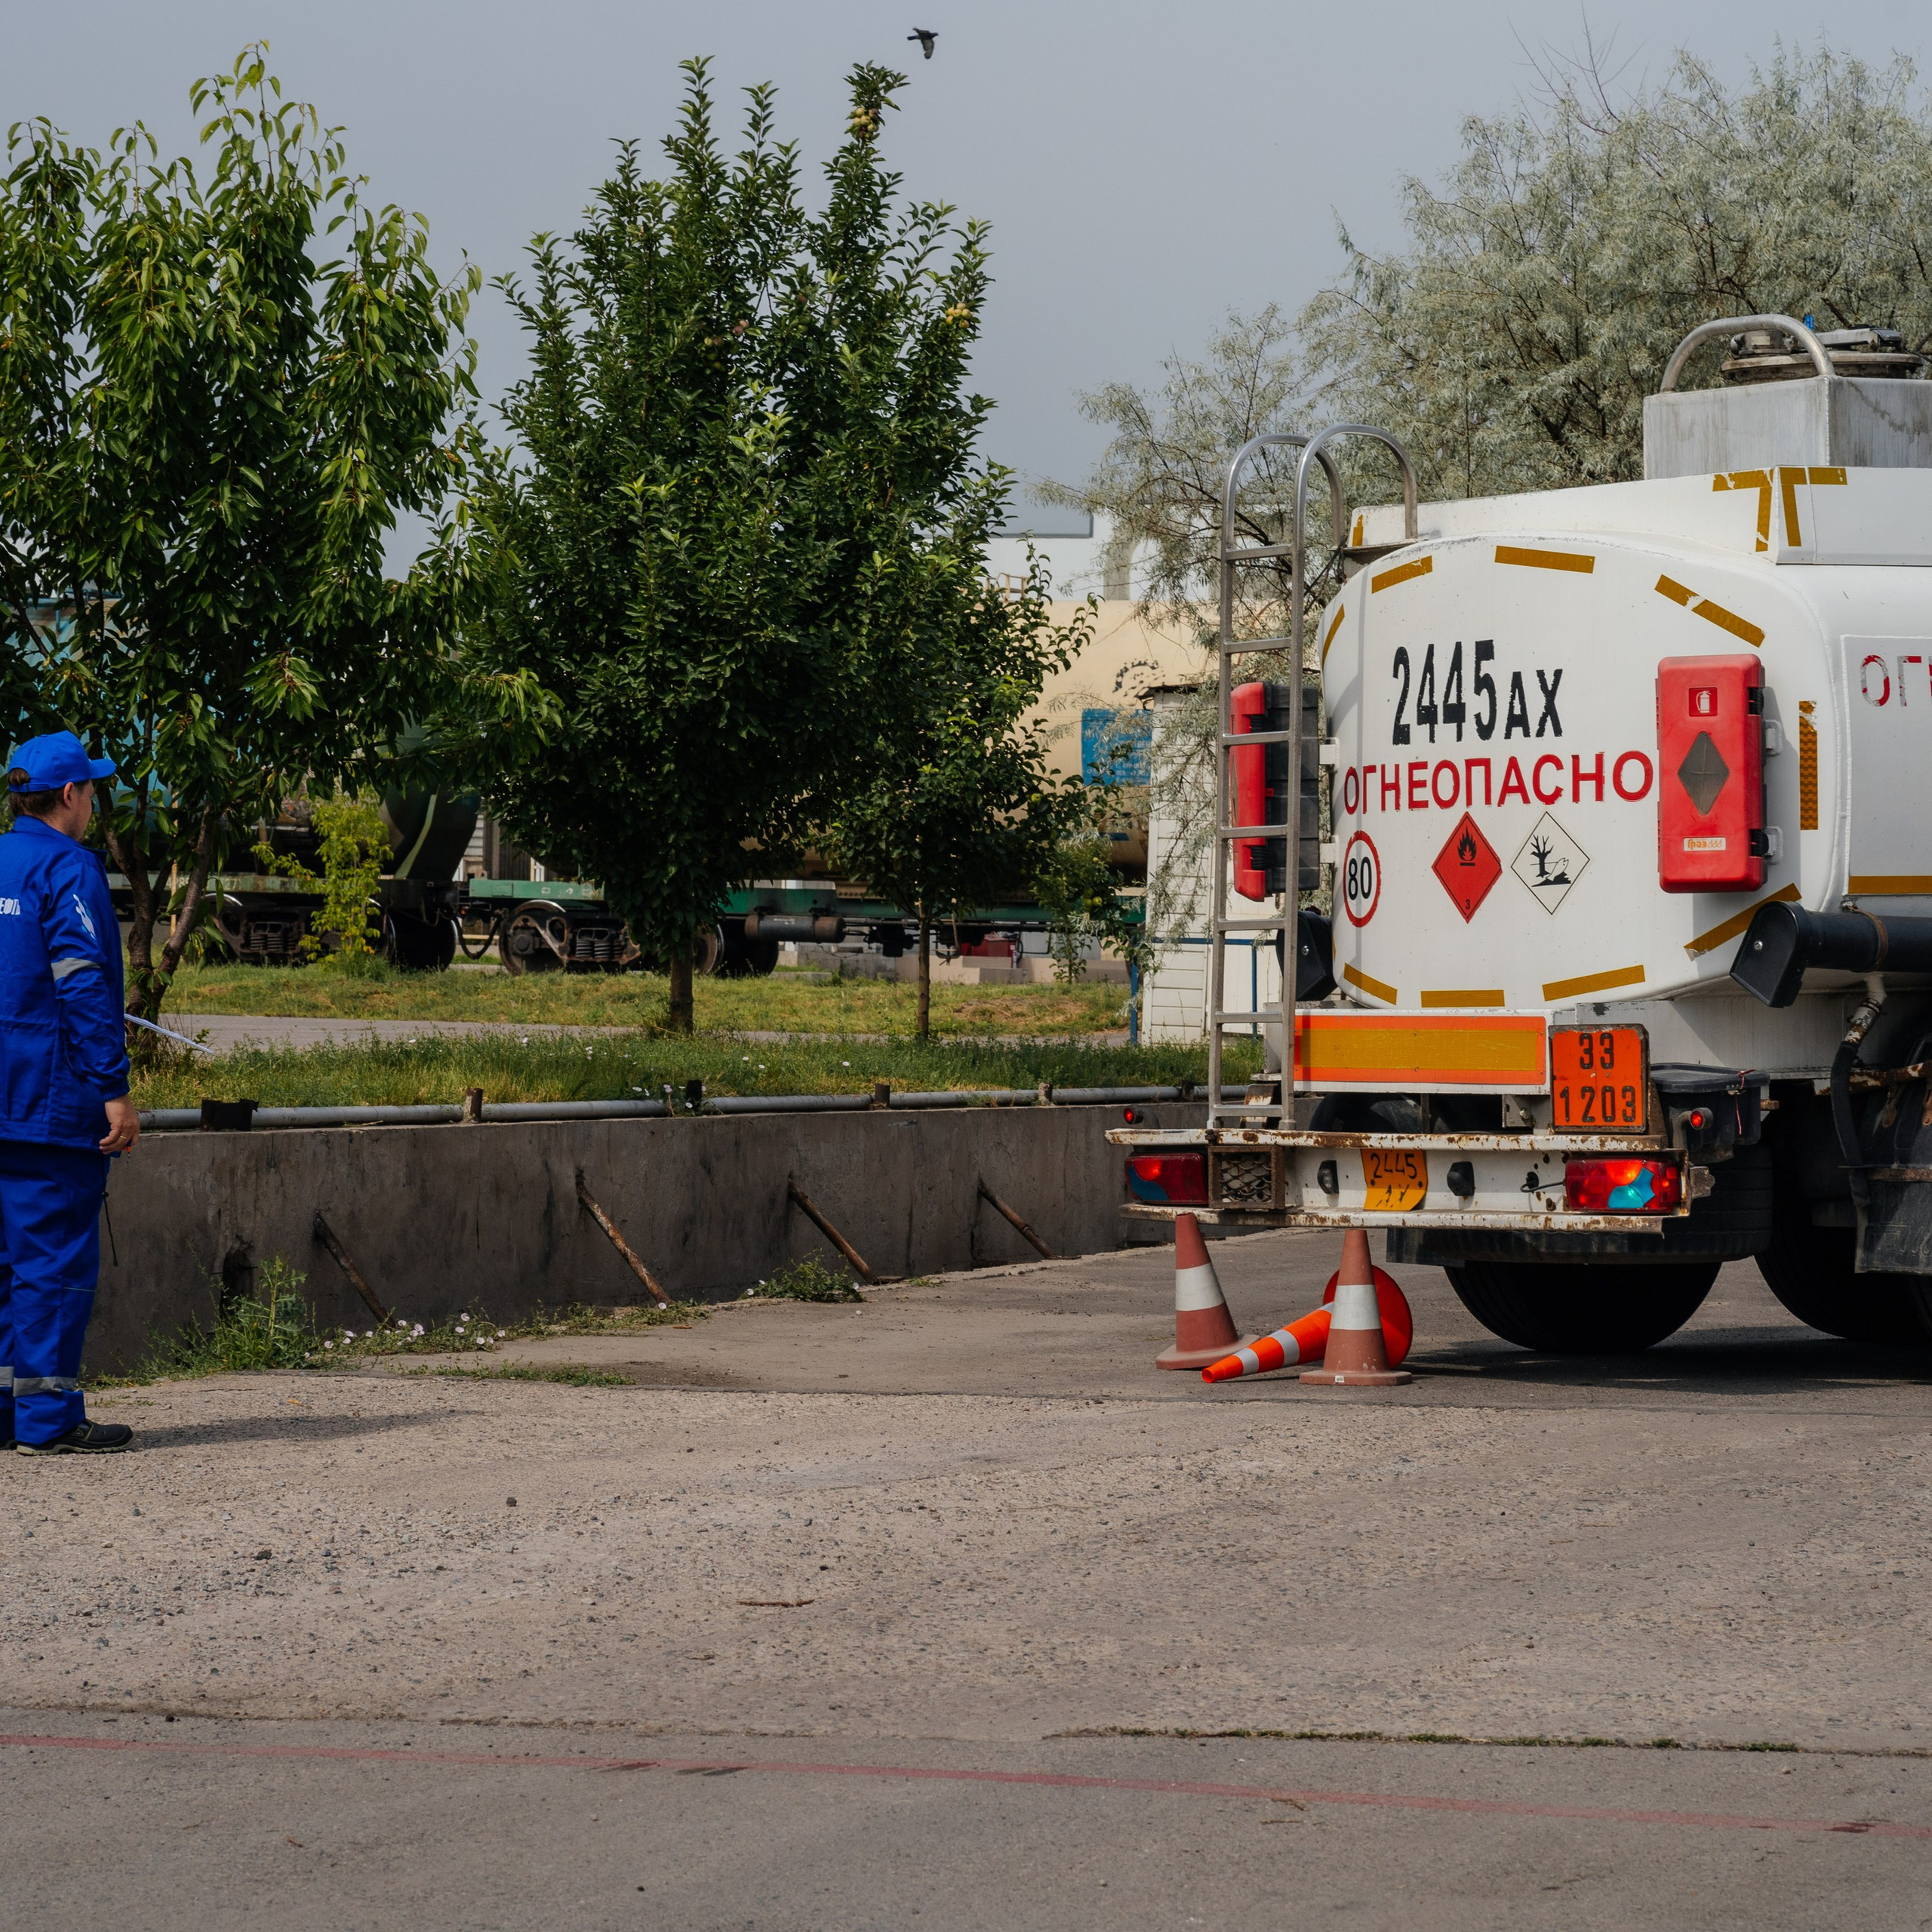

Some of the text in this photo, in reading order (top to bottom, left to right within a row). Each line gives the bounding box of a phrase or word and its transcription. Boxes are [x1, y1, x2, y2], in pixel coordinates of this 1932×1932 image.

[1860, 654, 1932, 707] ОГ
[1343, 750, 1654, 815] ОГНЕОПАСНО
[1348, 856, 1372, 900] 80
[1465, 899, 1471, 909] 3
[1579, 1032, 1614, 1070] 33
[1559, 1086, 1636, 1123] 1203
[1371, 1153, 1417, 1180] 2445
